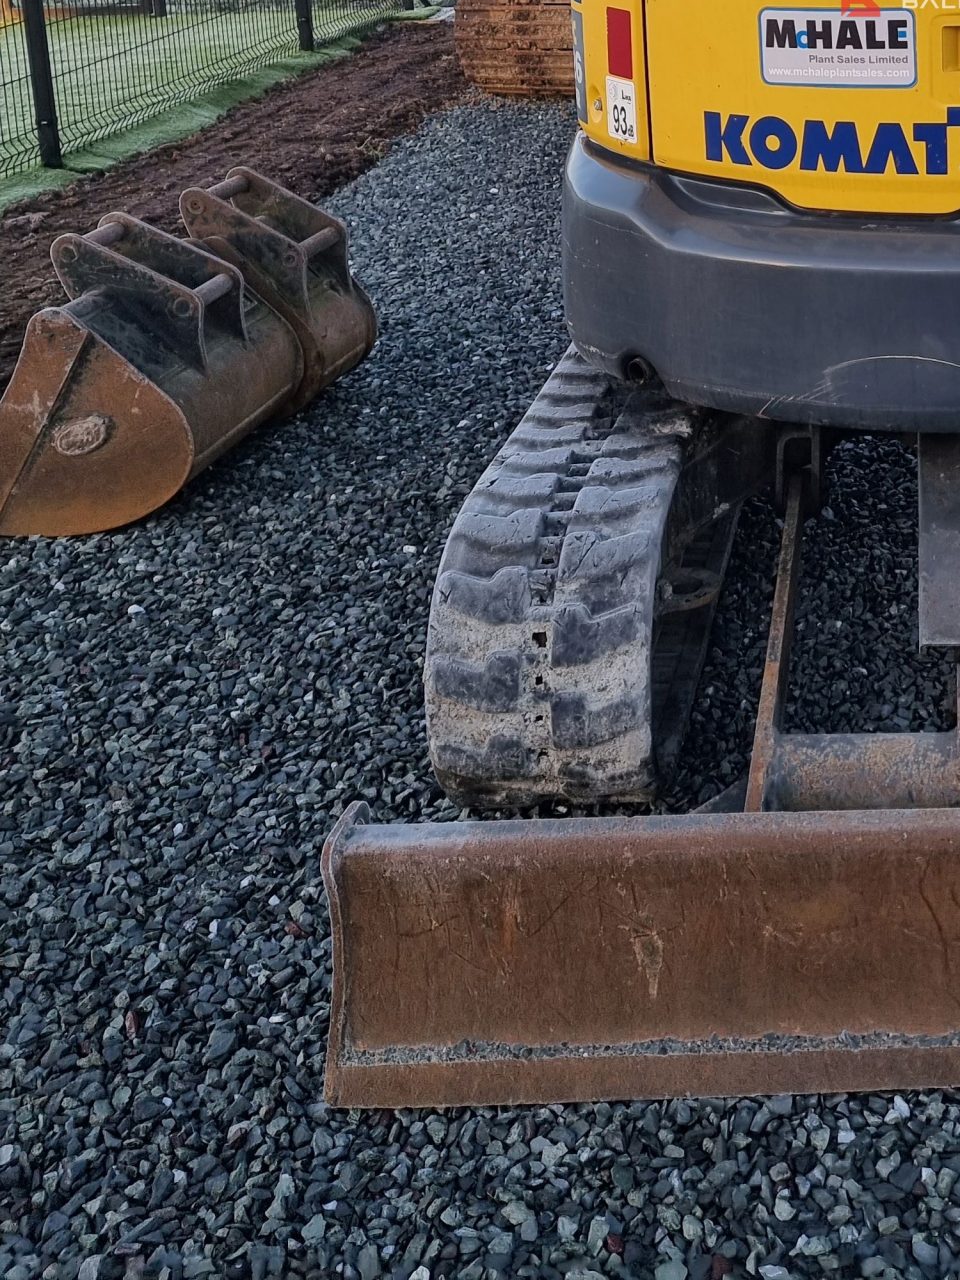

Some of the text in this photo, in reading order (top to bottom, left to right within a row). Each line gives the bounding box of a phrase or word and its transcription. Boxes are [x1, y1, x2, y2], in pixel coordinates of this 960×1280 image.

[809, 54, 909, 64] Plant Sales Limited
[768, 67, 910, 79] www.mchaleplantsales.com
